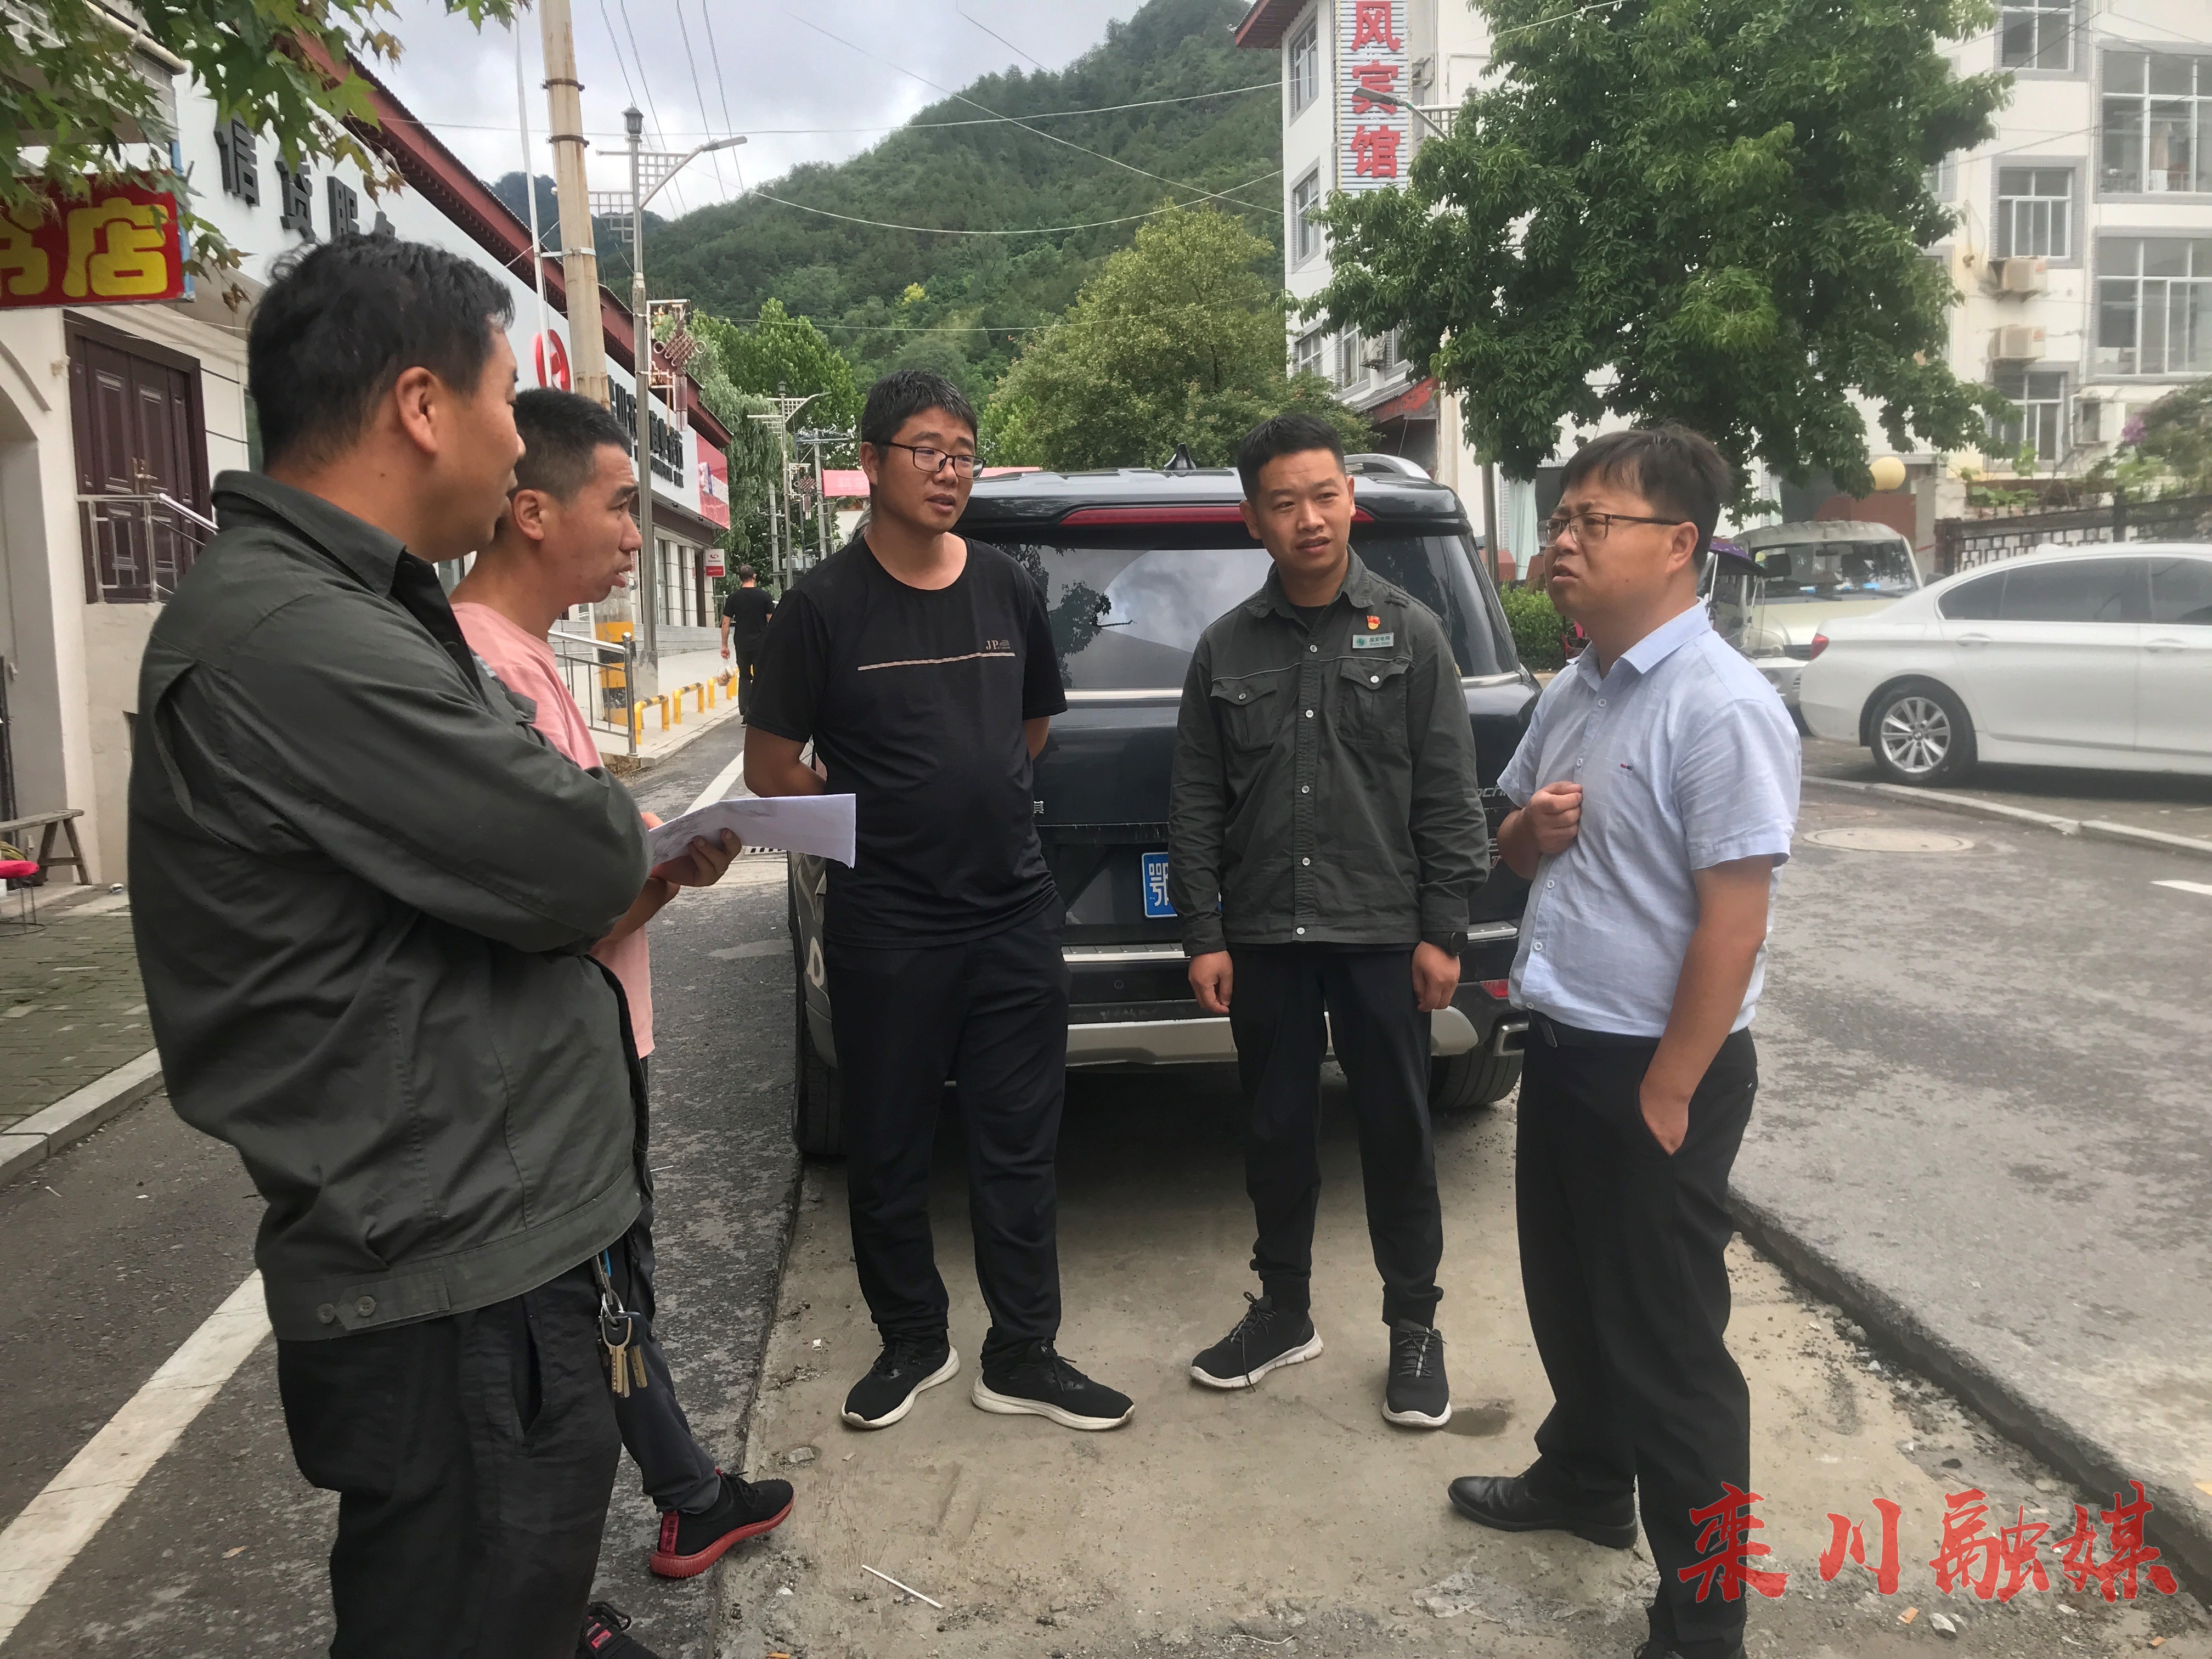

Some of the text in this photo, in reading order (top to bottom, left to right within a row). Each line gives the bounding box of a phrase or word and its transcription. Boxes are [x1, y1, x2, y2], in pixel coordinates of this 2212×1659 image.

[1350, 0, 1401, 179] 风宾馆
[214, 111, 395, 245] 信贷服
